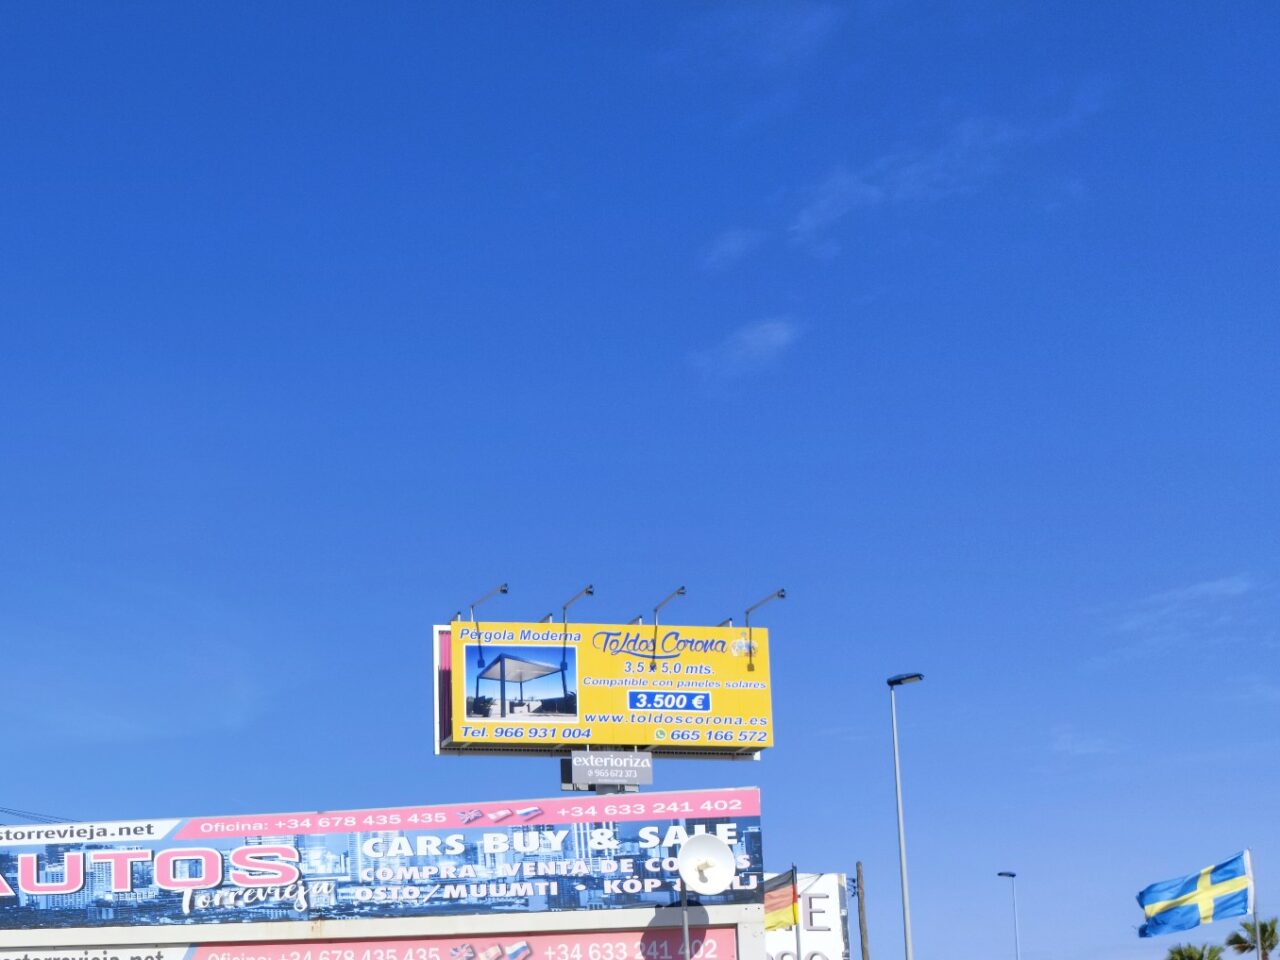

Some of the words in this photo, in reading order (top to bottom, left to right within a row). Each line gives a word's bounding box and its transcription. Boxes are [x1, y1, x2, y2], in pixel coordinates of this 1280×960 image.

[520, 629, 581, 641] Moderna
[592, 631, 656, 656] Toldos
[661, 632, 727, 653] Corona
[582, 676, 649, 688] Compatible
[652, 679, 673, 688] con
[676, 679, 721, 690] paneles
[725, 680, 767, 689] solares
[635, 693, 687, 709] 3.500
[692, 694, 705, 709] €
[584, 713, 768, 726] www.toldoscorona.es
[462, 726, 489, 738] Tel.
[494, 727, 524, 738] 966
[528, 728, 557, 738] 931
[562, 728, 591, 739] 004
[670, 730, 700, 741] 665
[706, 730, 733, 741] 166
[738, 731, 768, 742] 572
[573, 755, 652, 768] exterioriza
[594, 769, 609, 777] 965
[610, 769, 623, 778] 672
[625, 769, 637, 778] 373
[557, 805, 597, 817] +34
[604, 803, 645, 816] 633
[652, 801, 694, 814] 241
[700, 799, 742, 812] 402
[200, 821, 268, 834] Oficina:
[275, 818, 312, 830] +34
[317, 816, 356, 828] 678
[362, 814, 402, 826] 435
[407, 812, 446, 824] 435
[361, 833, 466, 858] CARS
[483, 829, 570, 854] BUY
[588, 828, 621, 850] &
[360, 864, 479, 881] COMPRA
[503, 859, 590, 877] VENTA
[601, 859, 634, 874] DE
[604, 875, 662, 894] KÖP
[177, 879, 337, 915] Torrevieja
[588, 941, 627, 960] 633
[634, 940, 672, 960] 241
[678, 939, 717, 959] 402
